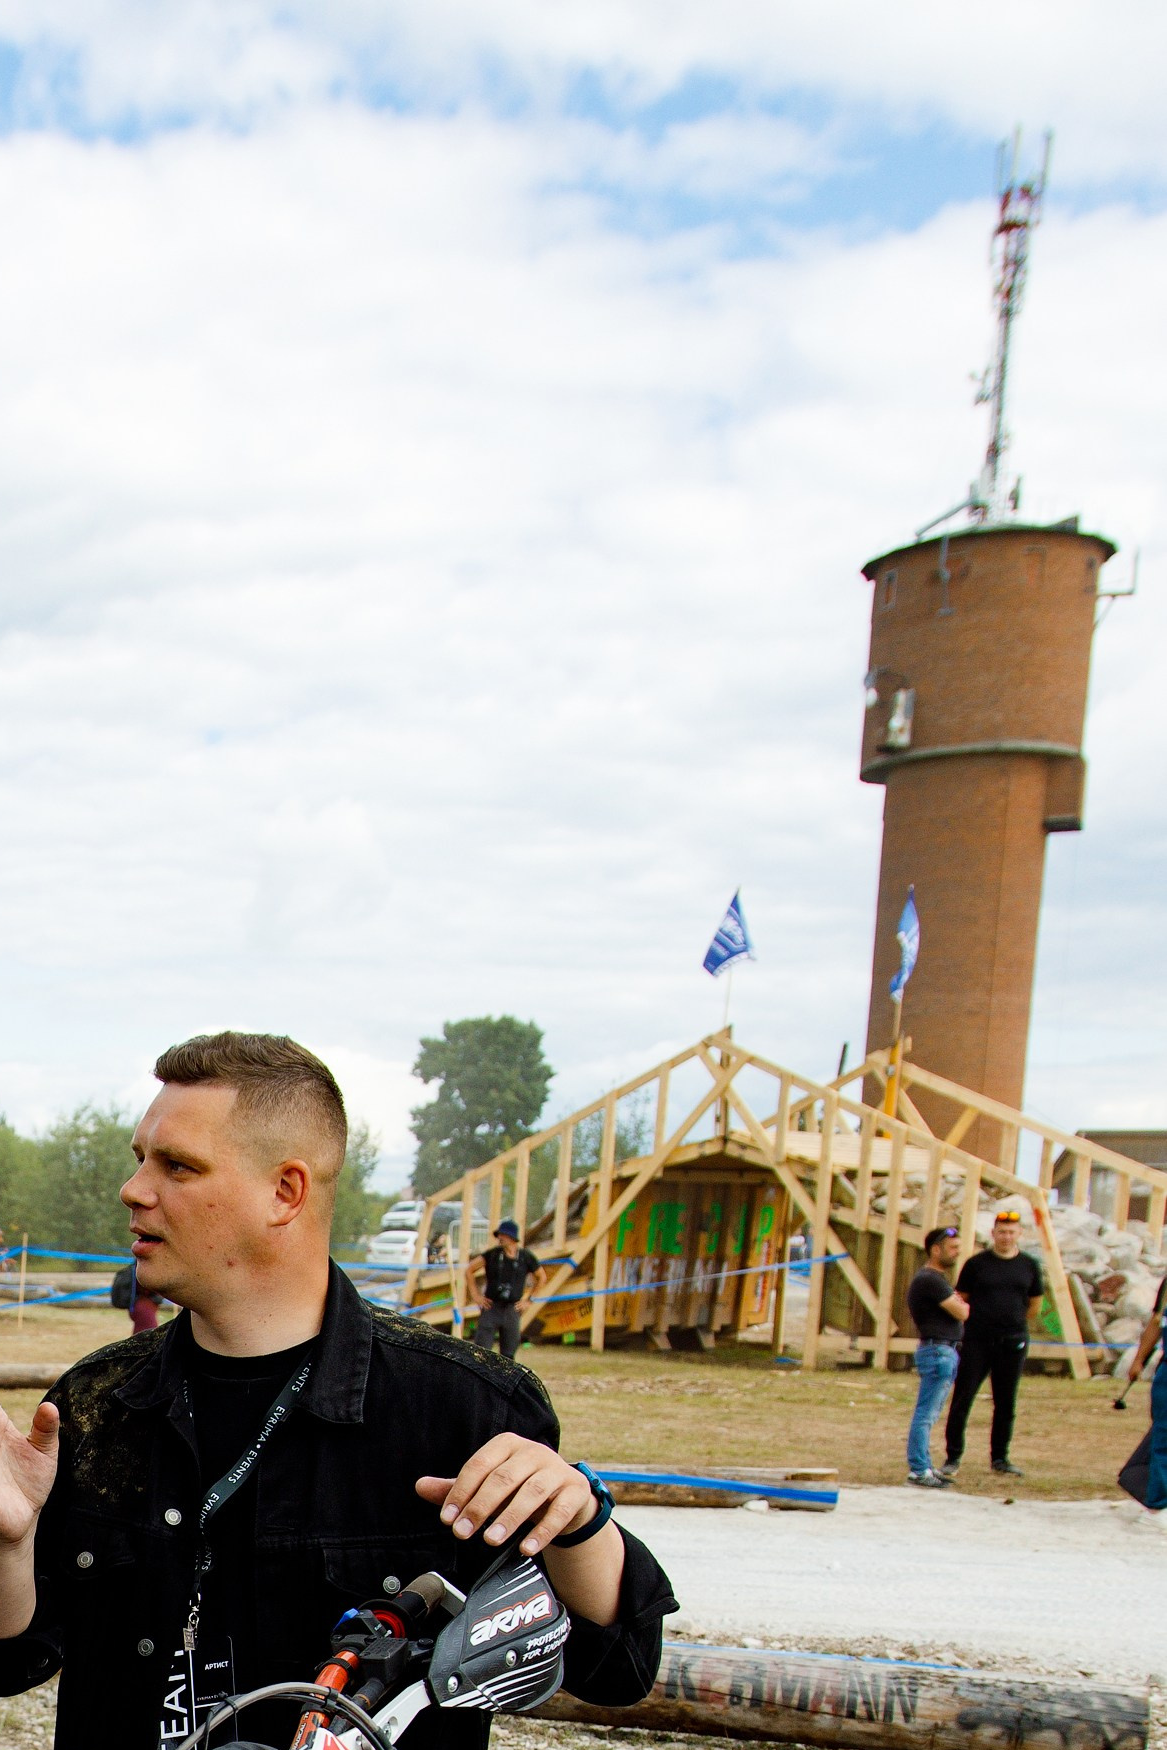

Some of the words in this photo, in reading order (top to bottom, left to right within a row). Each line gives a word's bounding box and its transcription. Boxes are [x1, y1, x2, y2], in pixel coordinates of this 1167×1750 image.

[257, 1405, 286, 1442] EVRIMA
[228, 1450, 258, 1484] EVENTS
[204, 1660, 229, 1671] АРТИСТ
[521, 1648, 542, 1663] FOR
